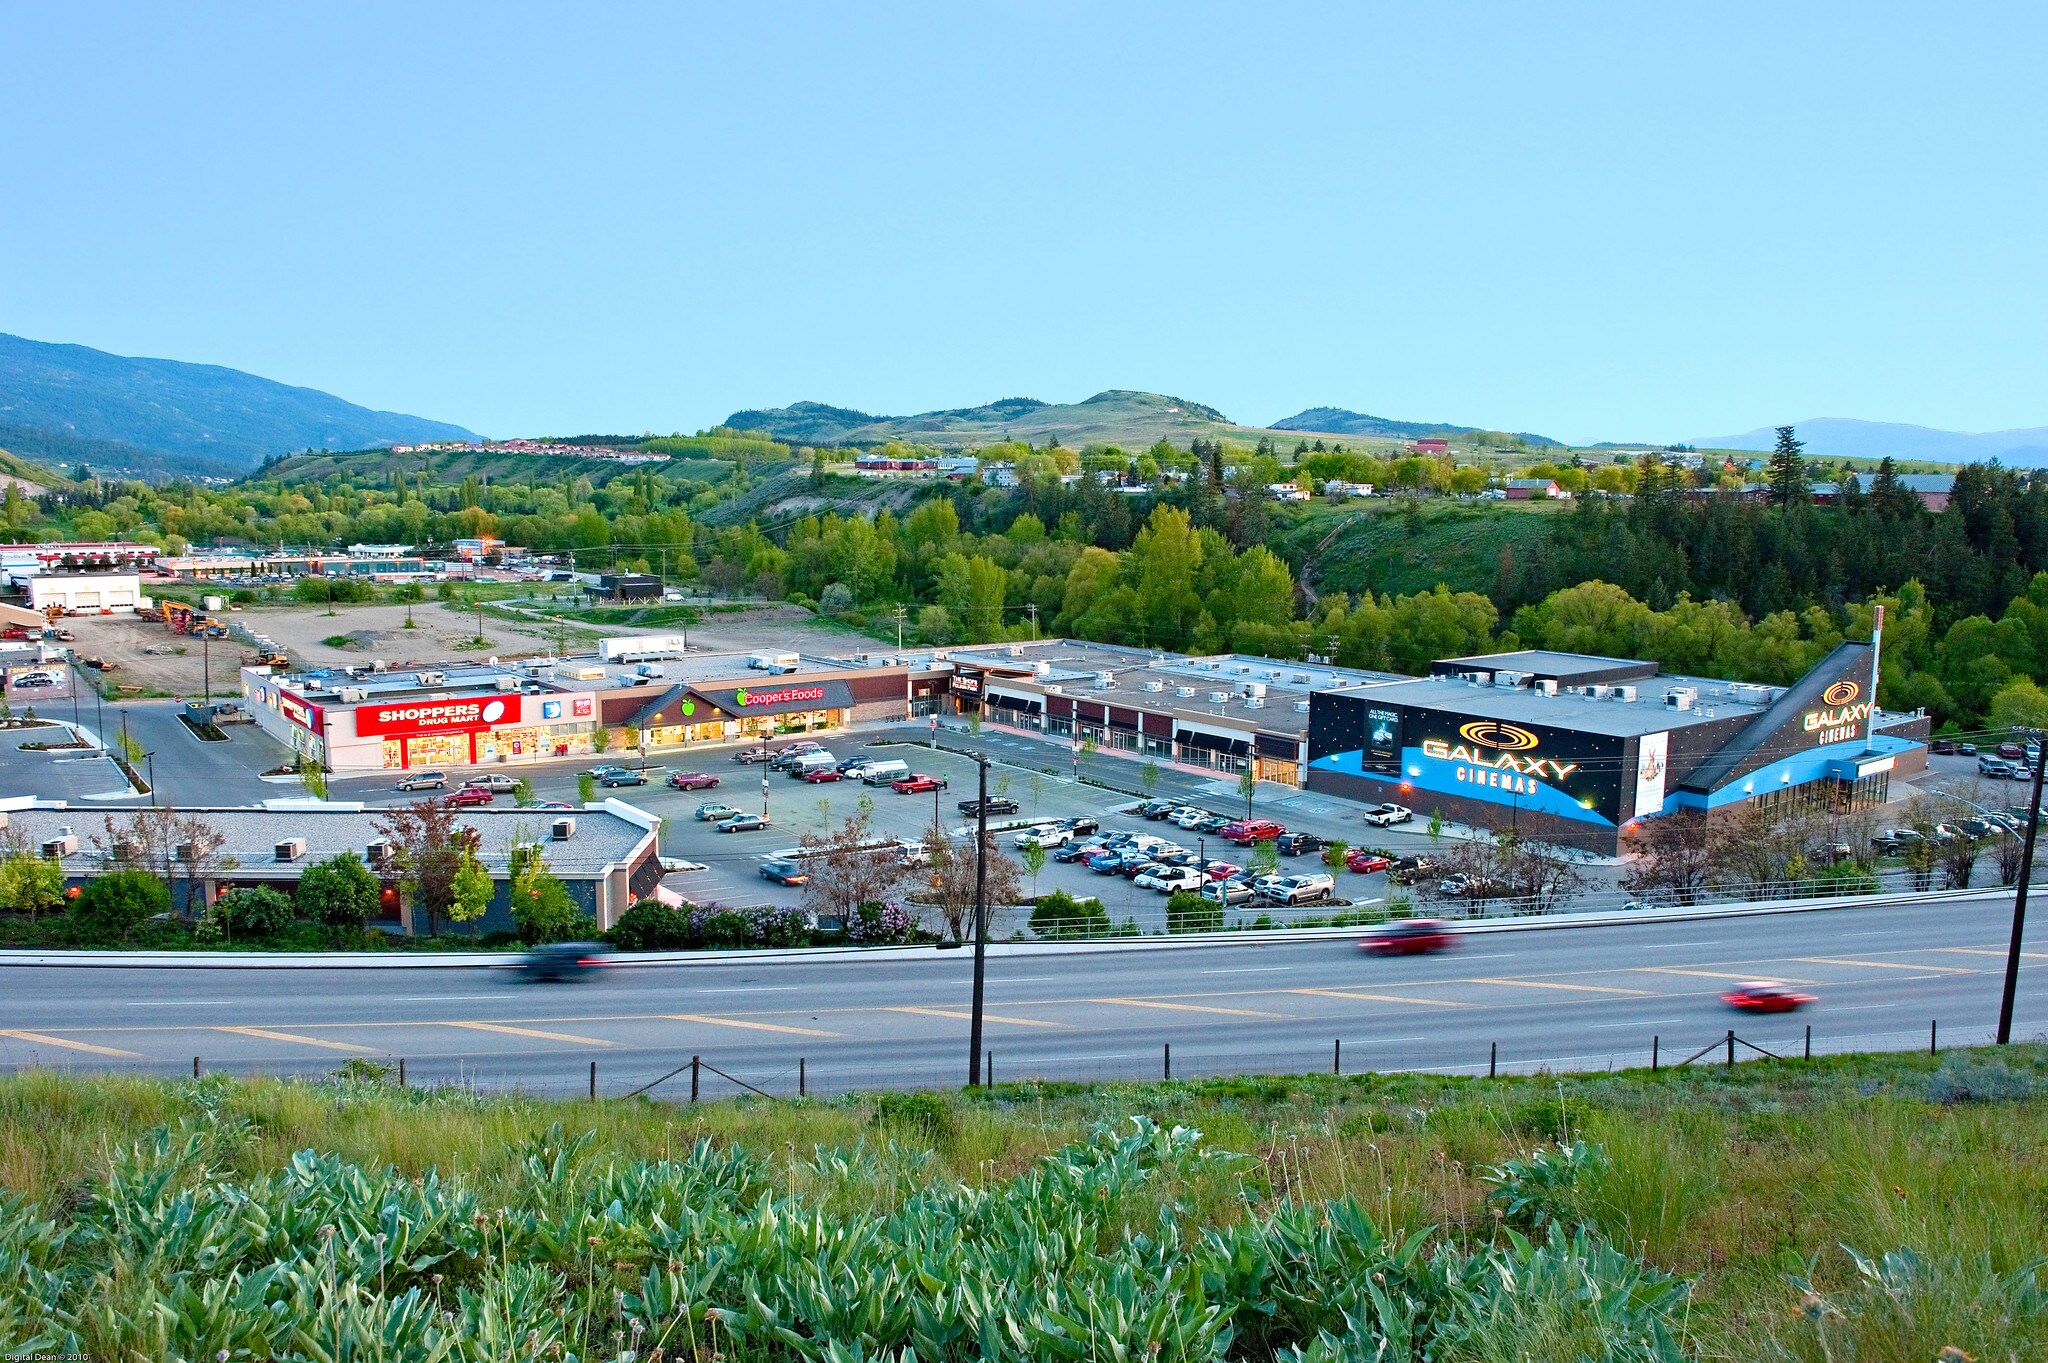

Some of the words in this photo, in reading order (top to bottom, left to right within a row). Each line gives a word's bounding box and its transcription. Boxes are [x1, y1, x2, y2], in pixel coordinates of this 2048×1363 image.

[744, 690, 789, 705] Cooper's
[791, 687, 823, 700] Foods
[378, 704, 480, 722] SHOPPERS
[418, 717, 448, 726] DRUG
[450, 714, 480, 723] MART
[1804, 701, 1874, 731] GALAXY
[1818, 723, 1856, 745] CINEMAS
[1423, 740, 1578, 781] GALAXY
[1456, 766, 1537, 795] CINEMAS
